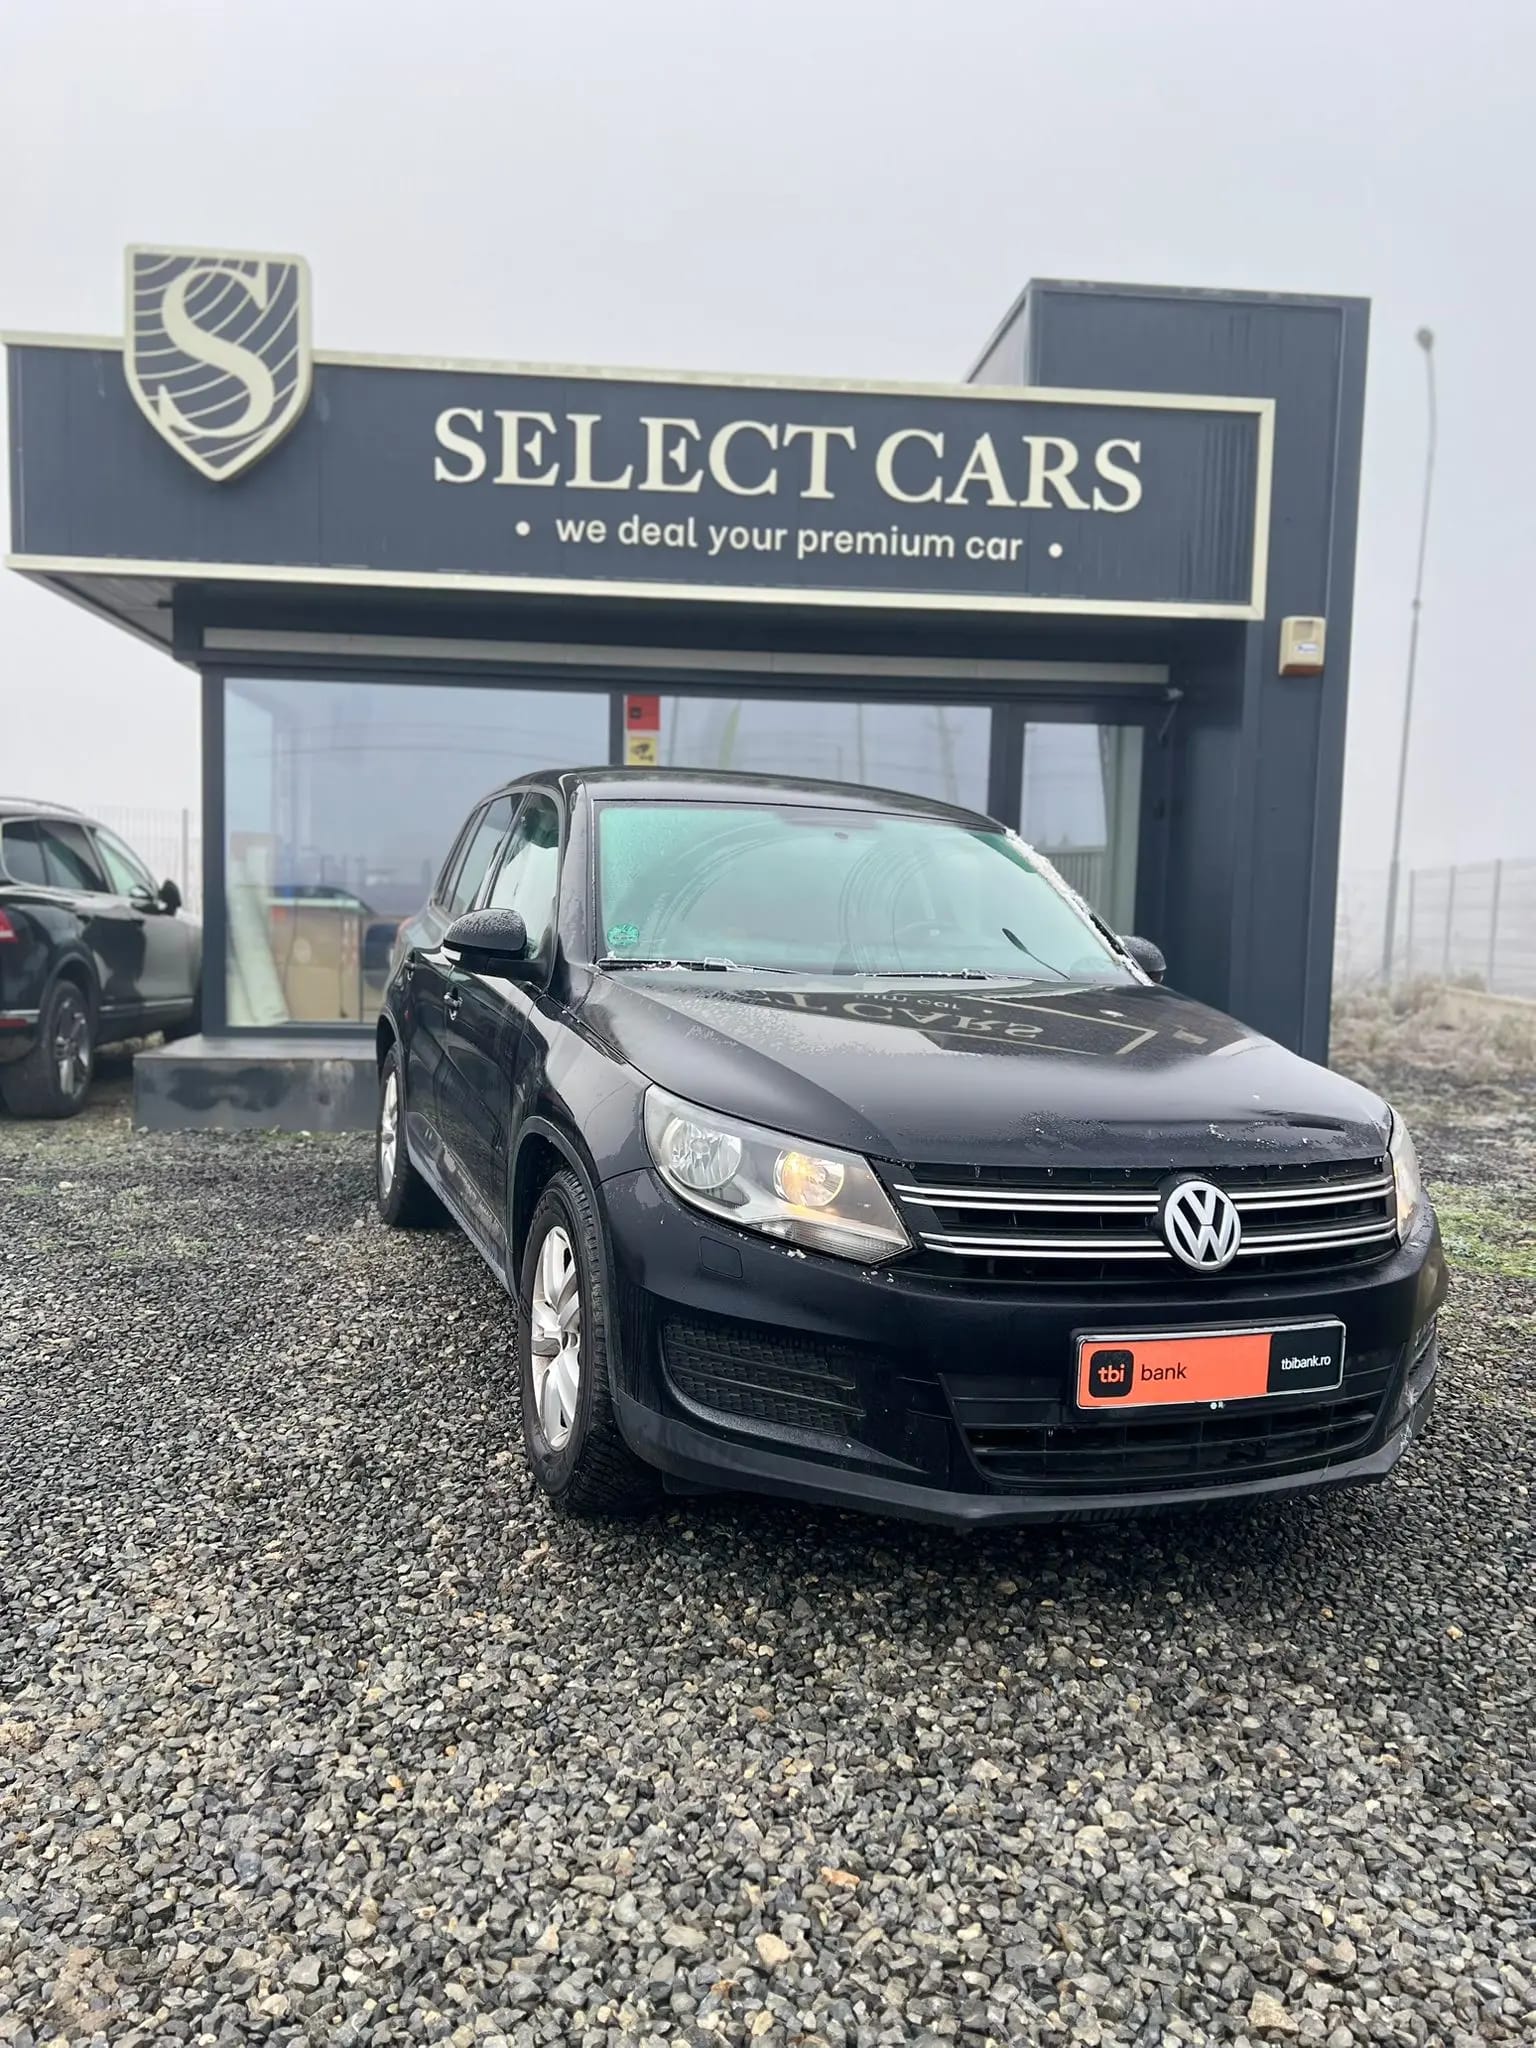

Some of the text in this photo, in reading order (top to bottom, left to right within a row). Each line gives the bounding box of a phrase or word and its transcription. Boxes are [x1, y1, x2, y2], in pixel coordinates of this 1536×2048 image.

[158, 263, 275, 438] S
[434, 407, 1143, 513] SELECT CARS
[556, 514, 1023, 561] we deal your premium car
[1168, 1185, 1238, 1267] VW
[1097, 1363, 1187, 1384] tbi bank
[1281, 1355, 1332, 1370] tbibank.ro
